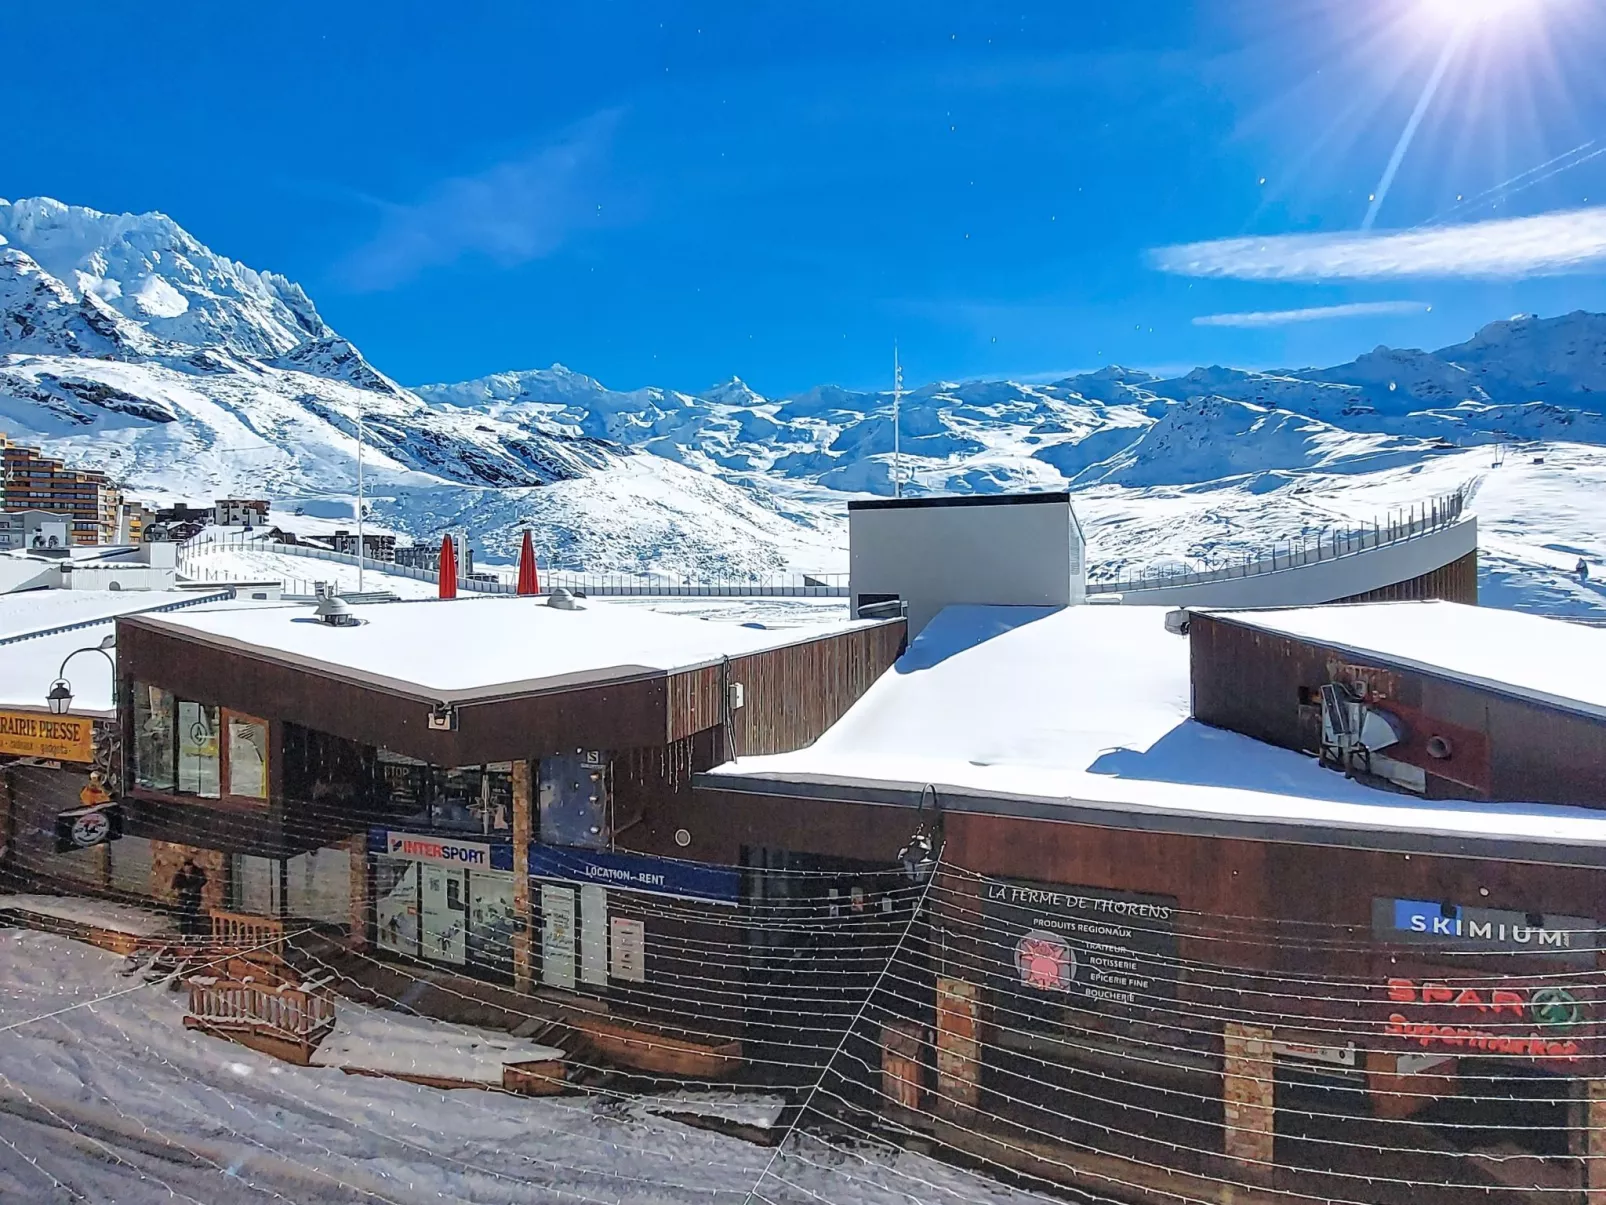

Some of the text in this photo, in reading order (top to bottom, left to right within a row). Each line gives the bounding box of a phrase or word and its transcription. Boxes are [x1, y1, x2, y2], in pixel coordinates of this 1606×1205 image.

[39, 720, 81, 742] PRESSE
[403, 840, 486, 864] INTERSPORT
[585, 866, 631, 881] LOCATION
[639, 872, 665, 886] RENT
[988, 886, 1171, 920] LA FERME DE THORENS
[1033, 918, 1132, 938] PRODUITS REGIONAUX
[1410, 914, 1562, 947] SKIMIUM
[1085, 942, 1126, 954] TRAITEUR
[1089, 956, 1137, 970] ROTISSERIE
[1090, 973, 1149, 989] EPICERIE FINE
[1085, 988, 1135, 1002] BOUCHERIE
[1387, 977, 1524, 1017] SPAR
